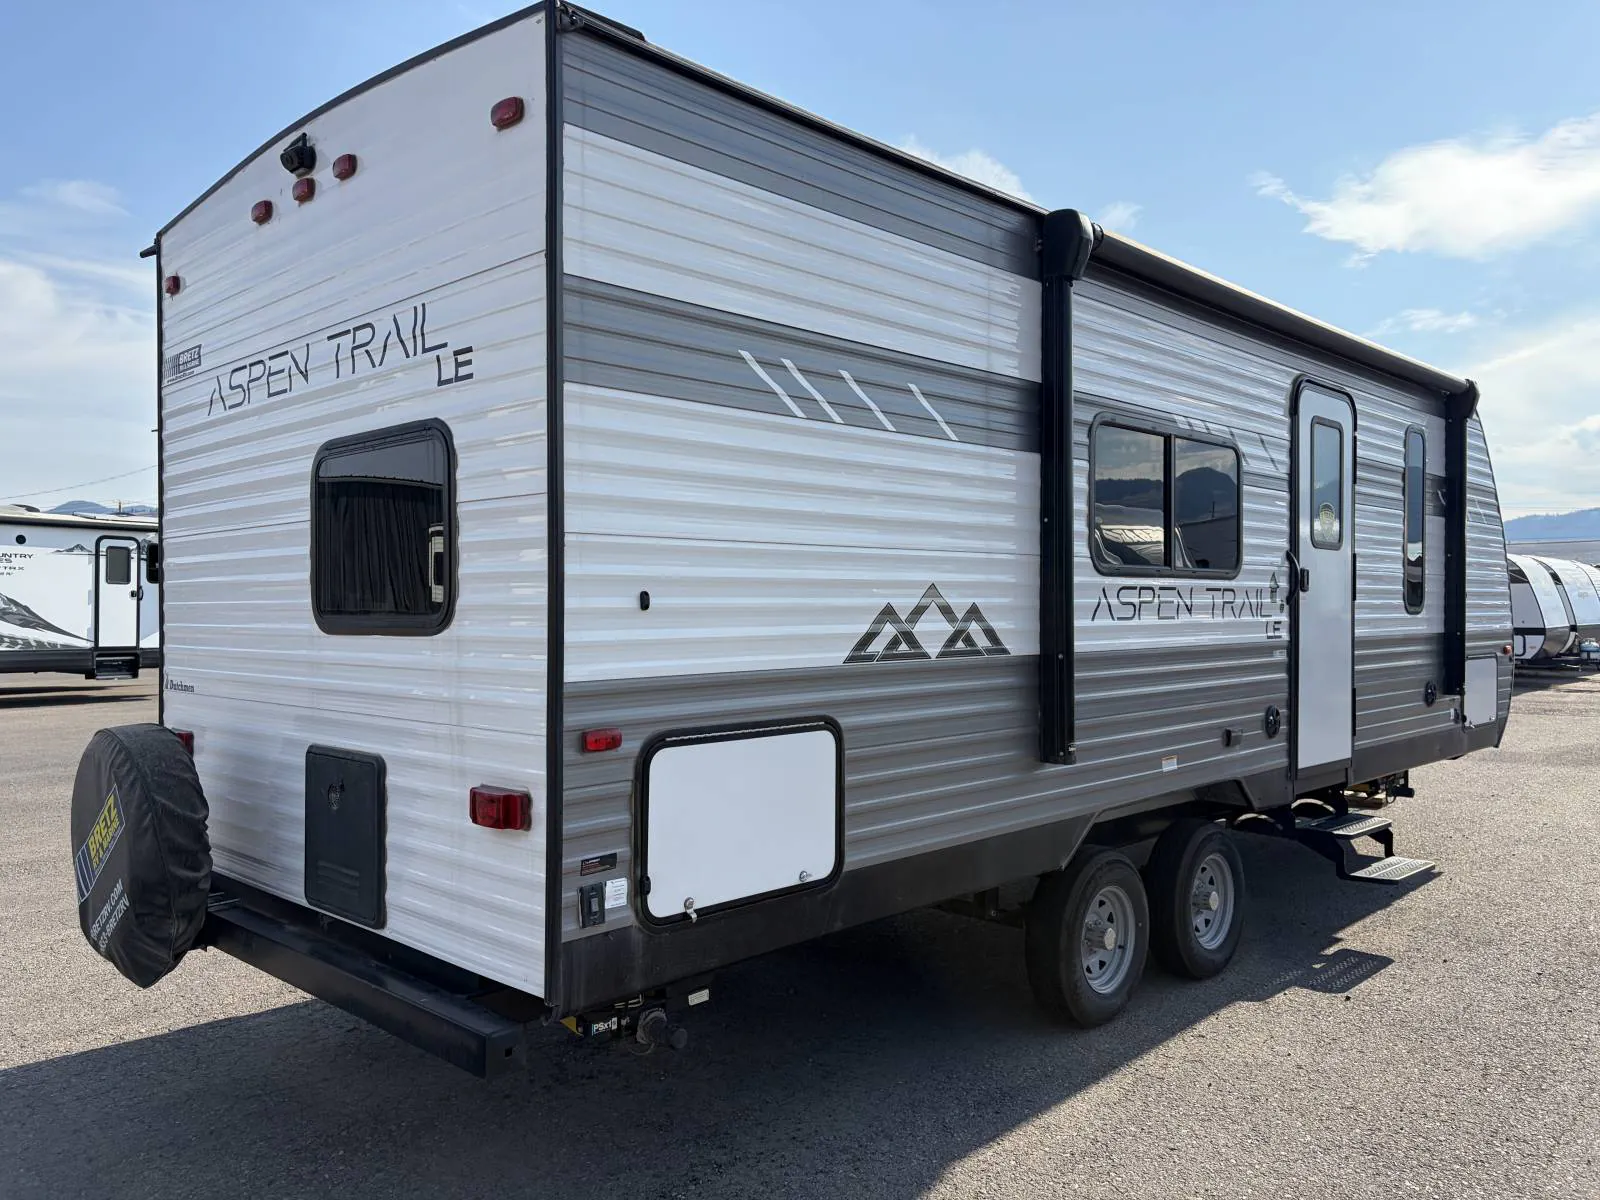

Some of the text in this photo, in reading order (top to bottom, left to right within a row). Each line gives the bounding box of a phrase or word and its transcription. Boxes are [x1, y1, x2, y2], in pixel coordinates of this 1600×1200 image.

[207, 303, 448, 416] ASPEN TRAIL
[436, 345, 474, 387] LE
[1091, 586, 1273, 621] ASPEN TRAIL
[1265, 620, 1282, 639] LE
[170, 679, 195, 692] Dutchmen
[88, 793, 118, 860] BRETZ
